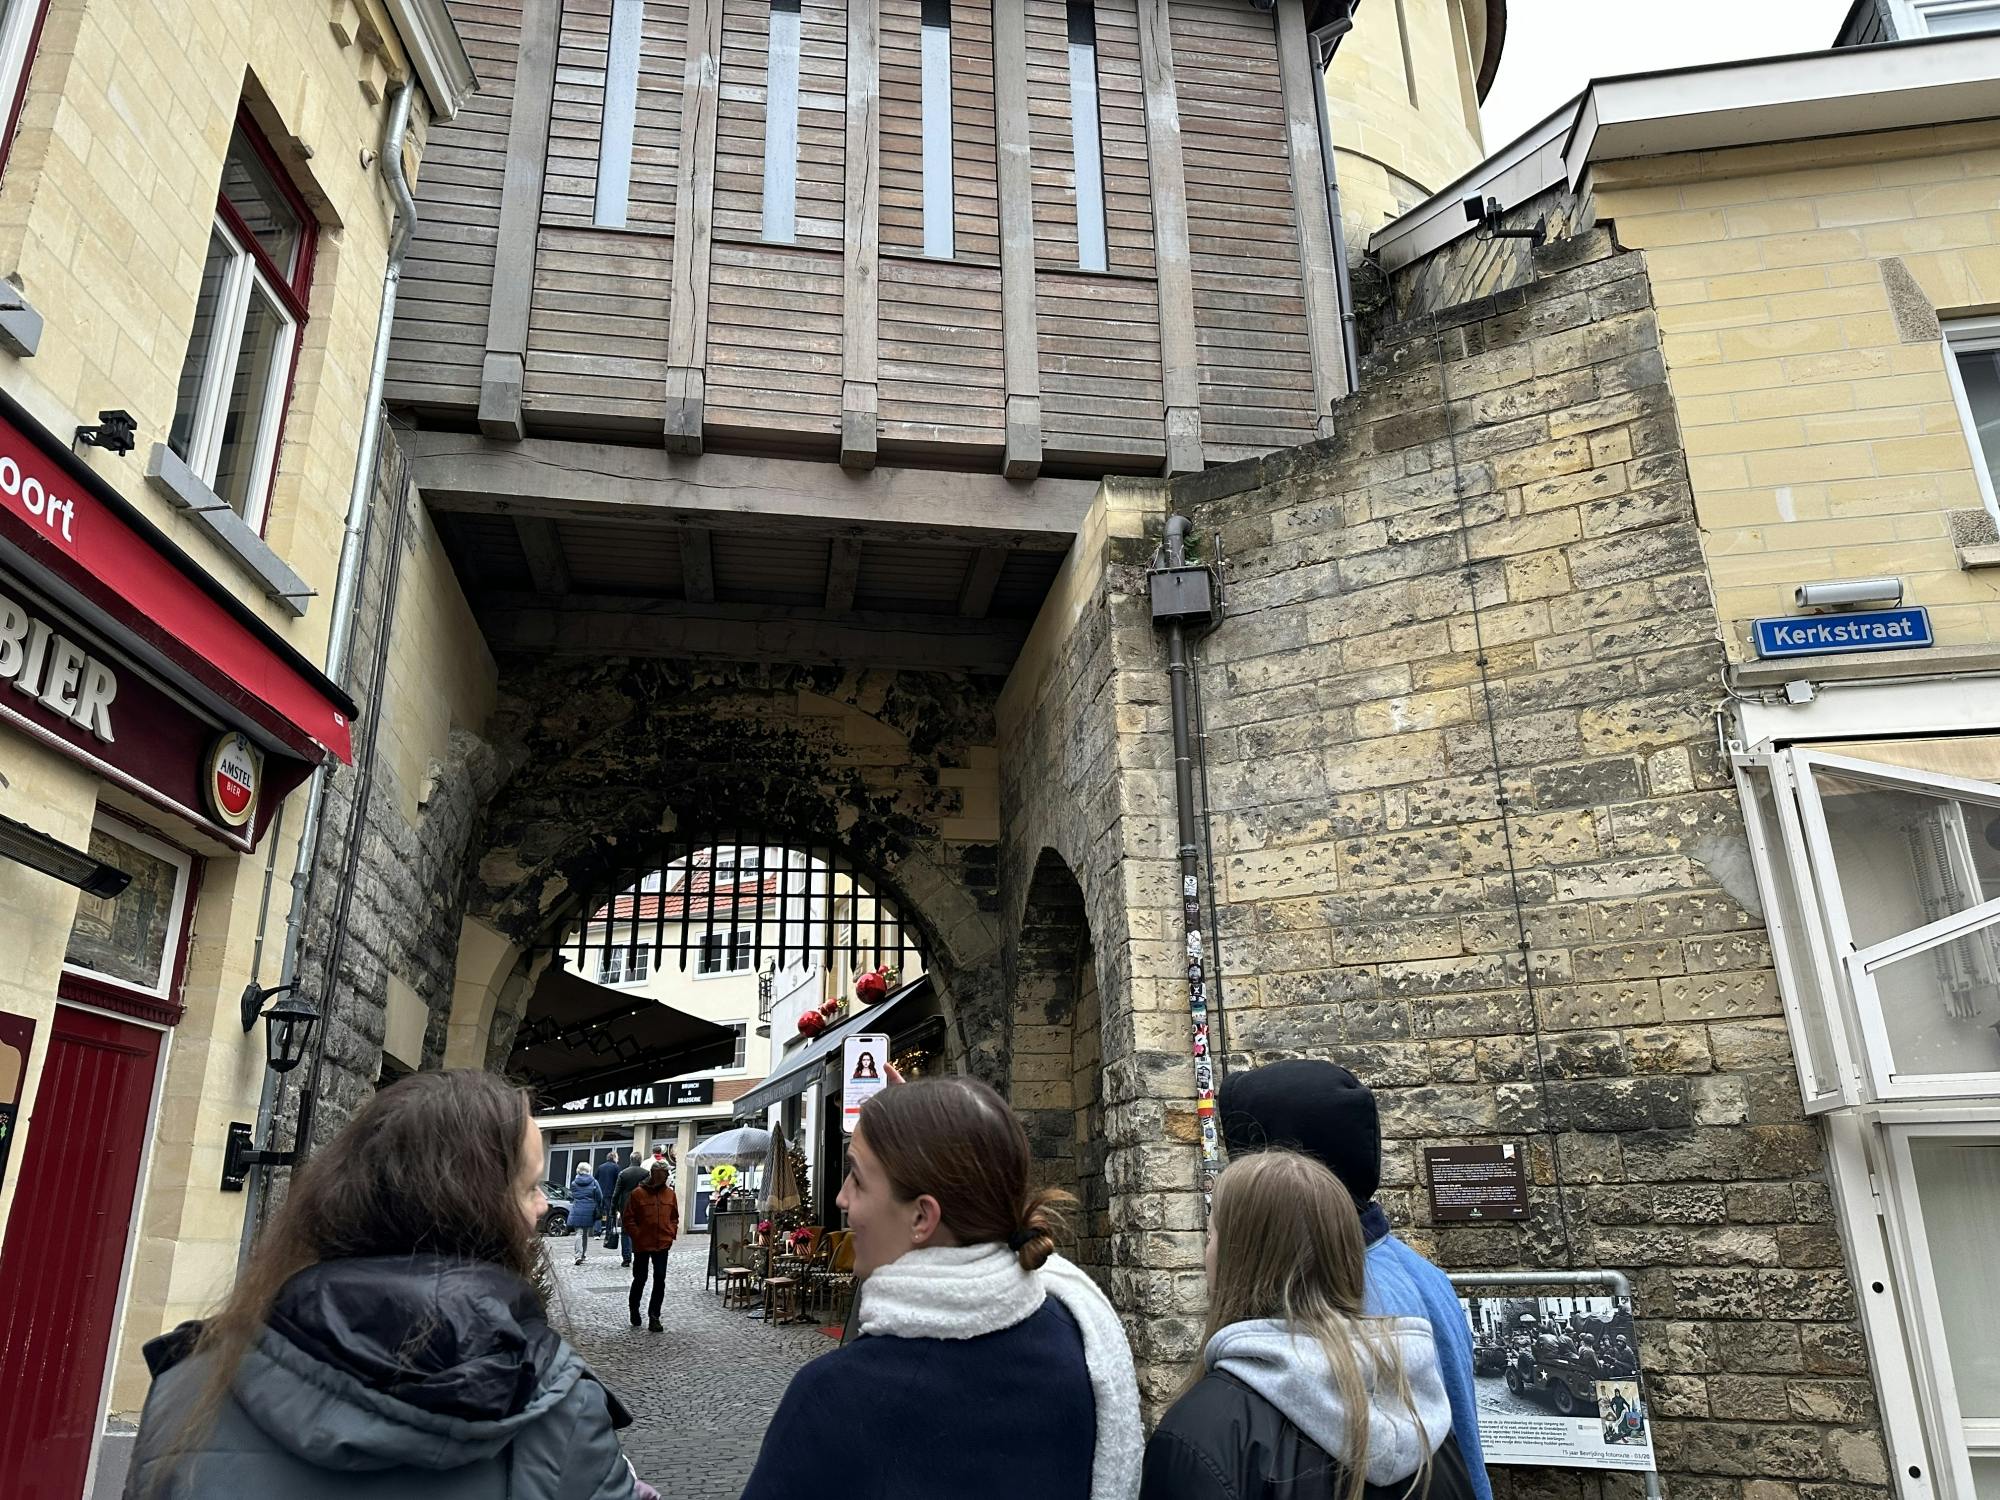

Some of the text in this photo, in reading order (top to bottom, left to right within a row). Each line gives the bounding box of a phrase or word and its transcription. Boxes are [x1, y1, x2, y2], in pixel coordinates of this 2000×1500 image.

[1773, 617, 1913, 646] Kerkstraat
[0, 594, 117, 743] BIER
[220, 758, 251, 788] AMSTEL
[226, 781, 241, 797] BIER
[593, 1087, 654, 1108] LOKMA
